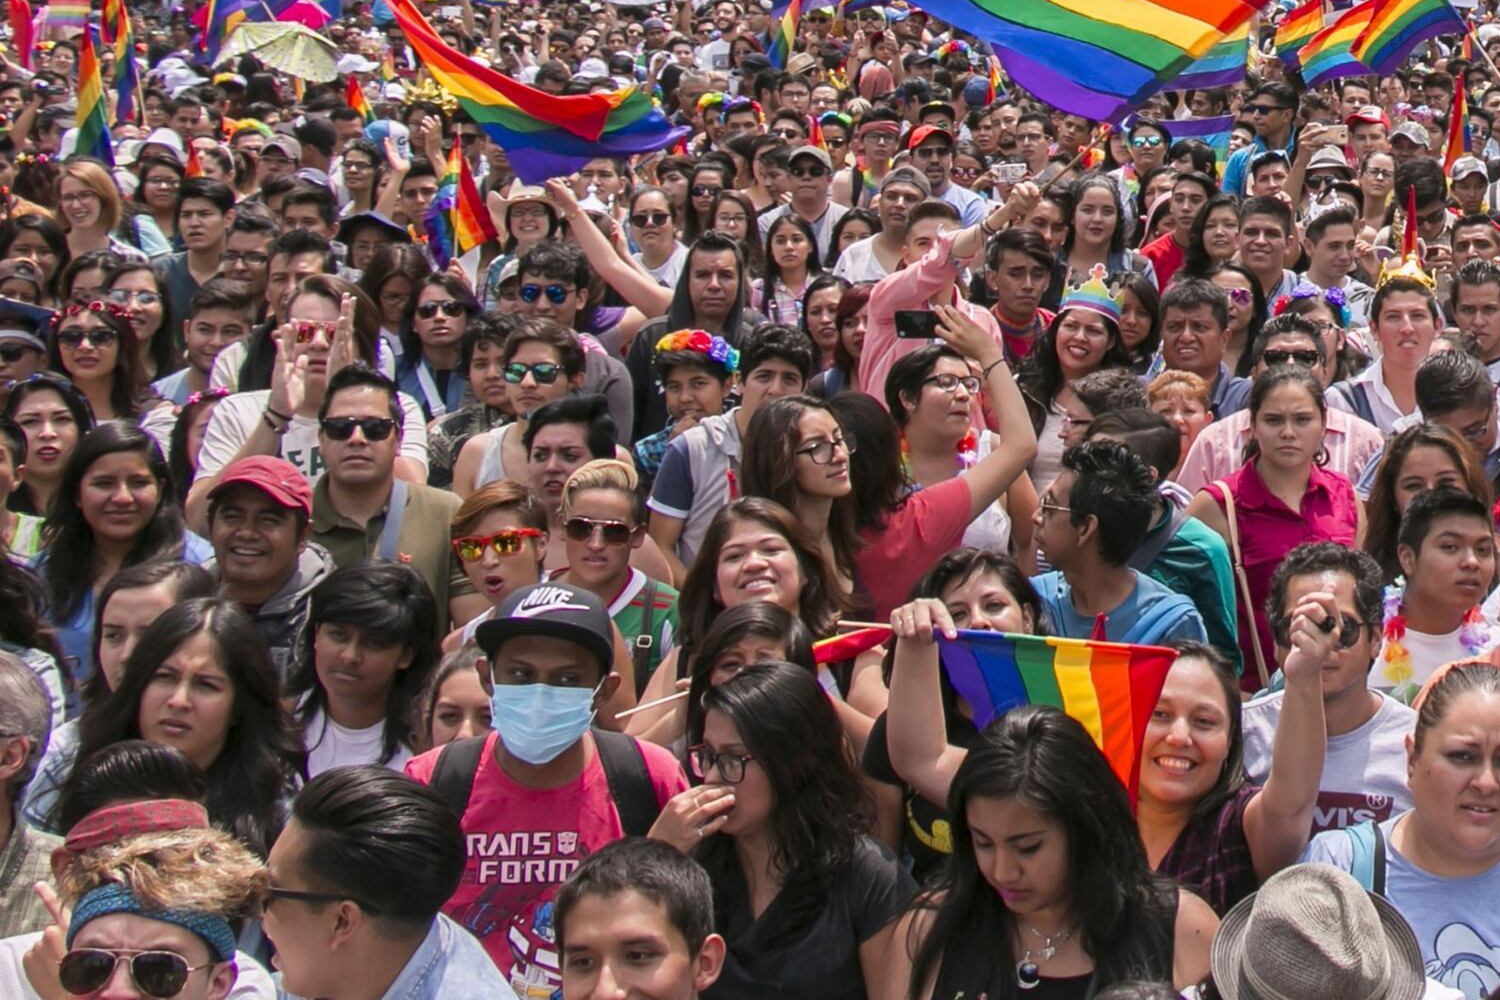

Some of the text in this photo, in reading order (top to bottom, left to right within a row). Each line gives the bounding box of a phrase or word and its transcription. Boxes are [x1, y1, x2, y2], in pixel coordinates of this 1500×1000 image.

[523, 587, 574, 605] NIKE
[1313, 806, 1377, 828] VI'S
[466, 832, 552, 857] RANS
[479, 859, 579, 884] FORM
